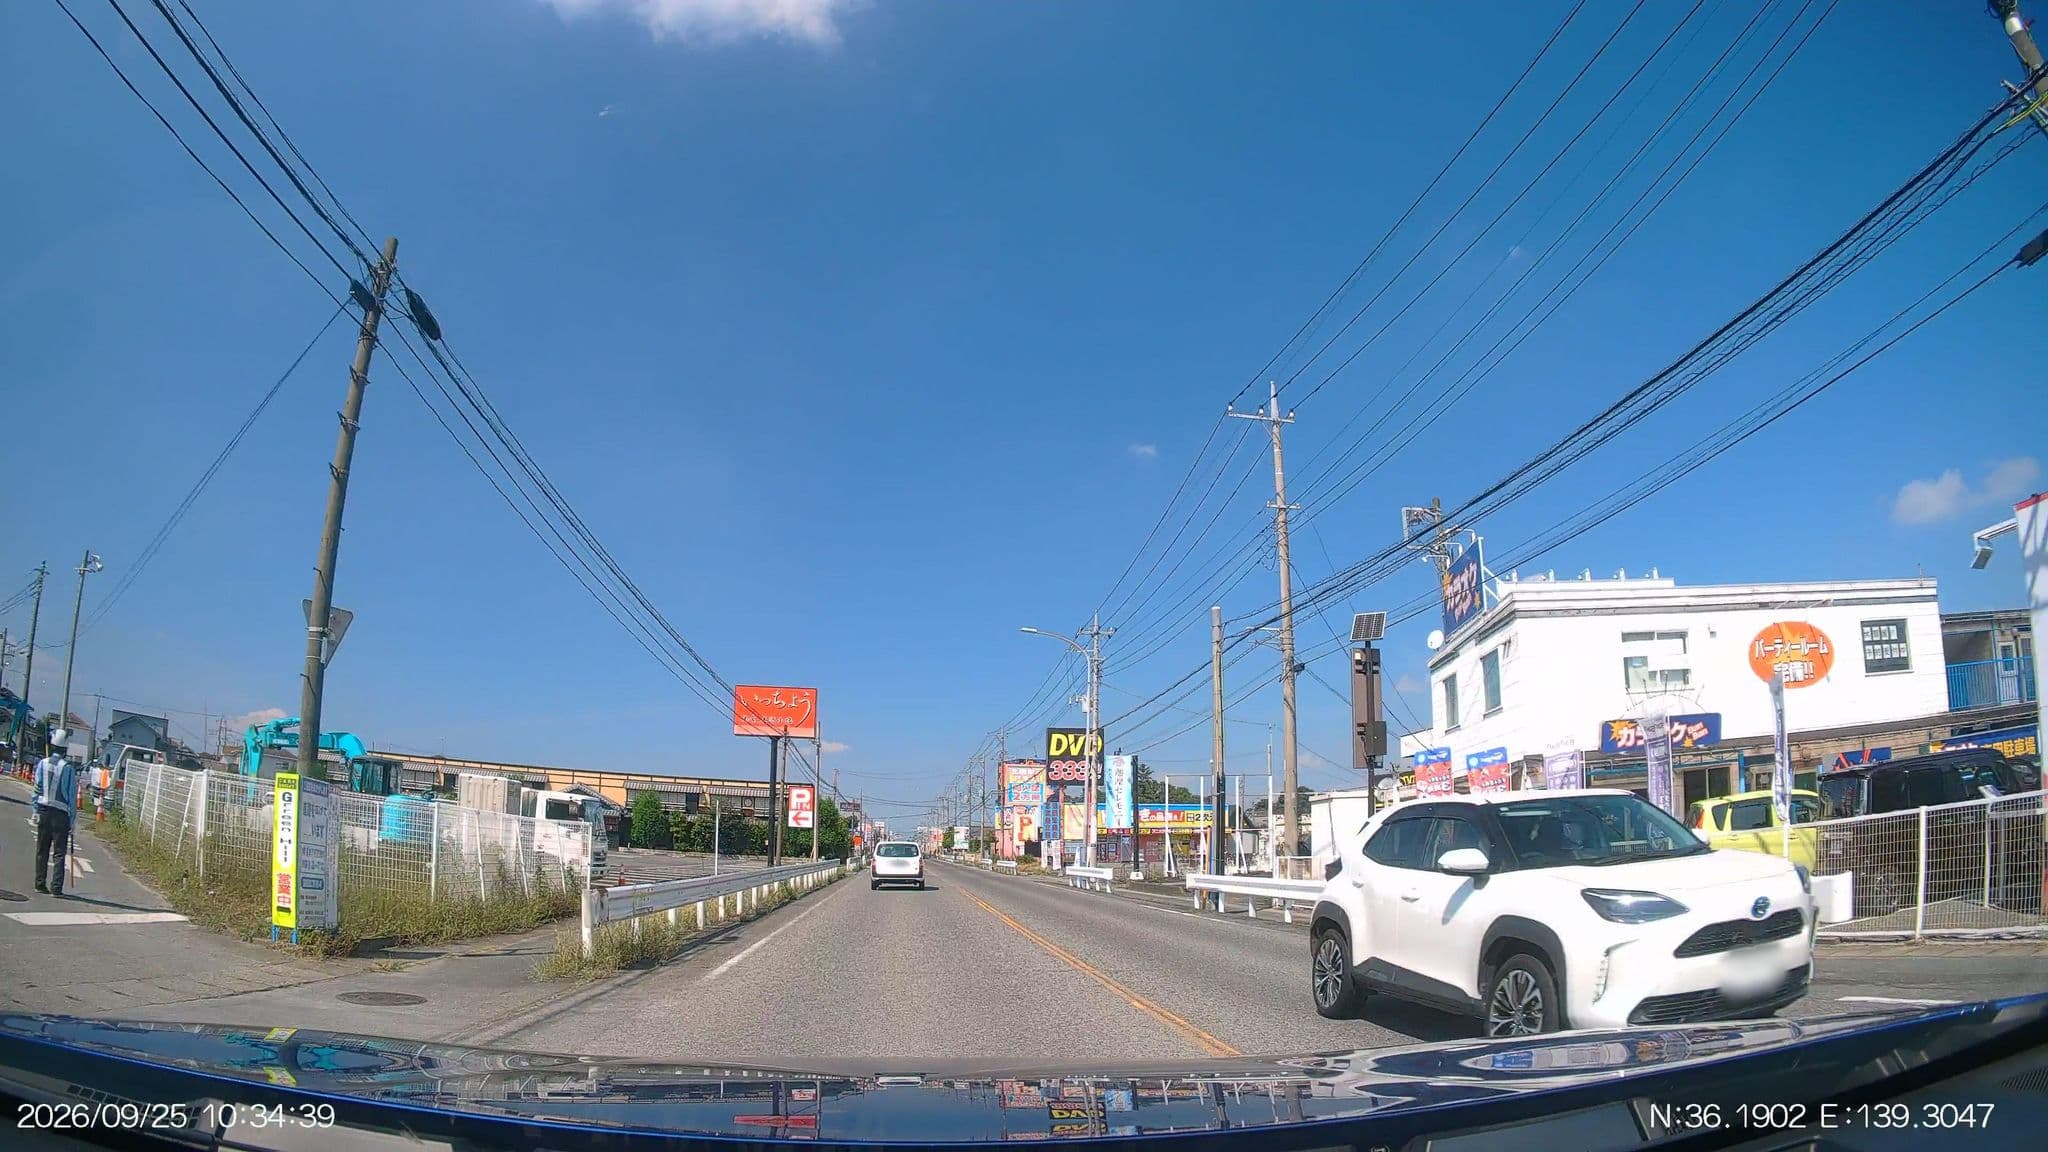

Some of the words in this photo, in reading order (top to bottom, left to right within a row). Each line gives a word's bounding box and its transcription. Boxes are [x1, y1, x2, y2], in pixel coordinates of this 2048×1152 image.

[1754, 636, 1830, 658] パーティールーム
[1049, 733, 1103, 757] DVD
[1617, 720, 1687, 749] カラケ
[281, 791, 293, 832] Green
